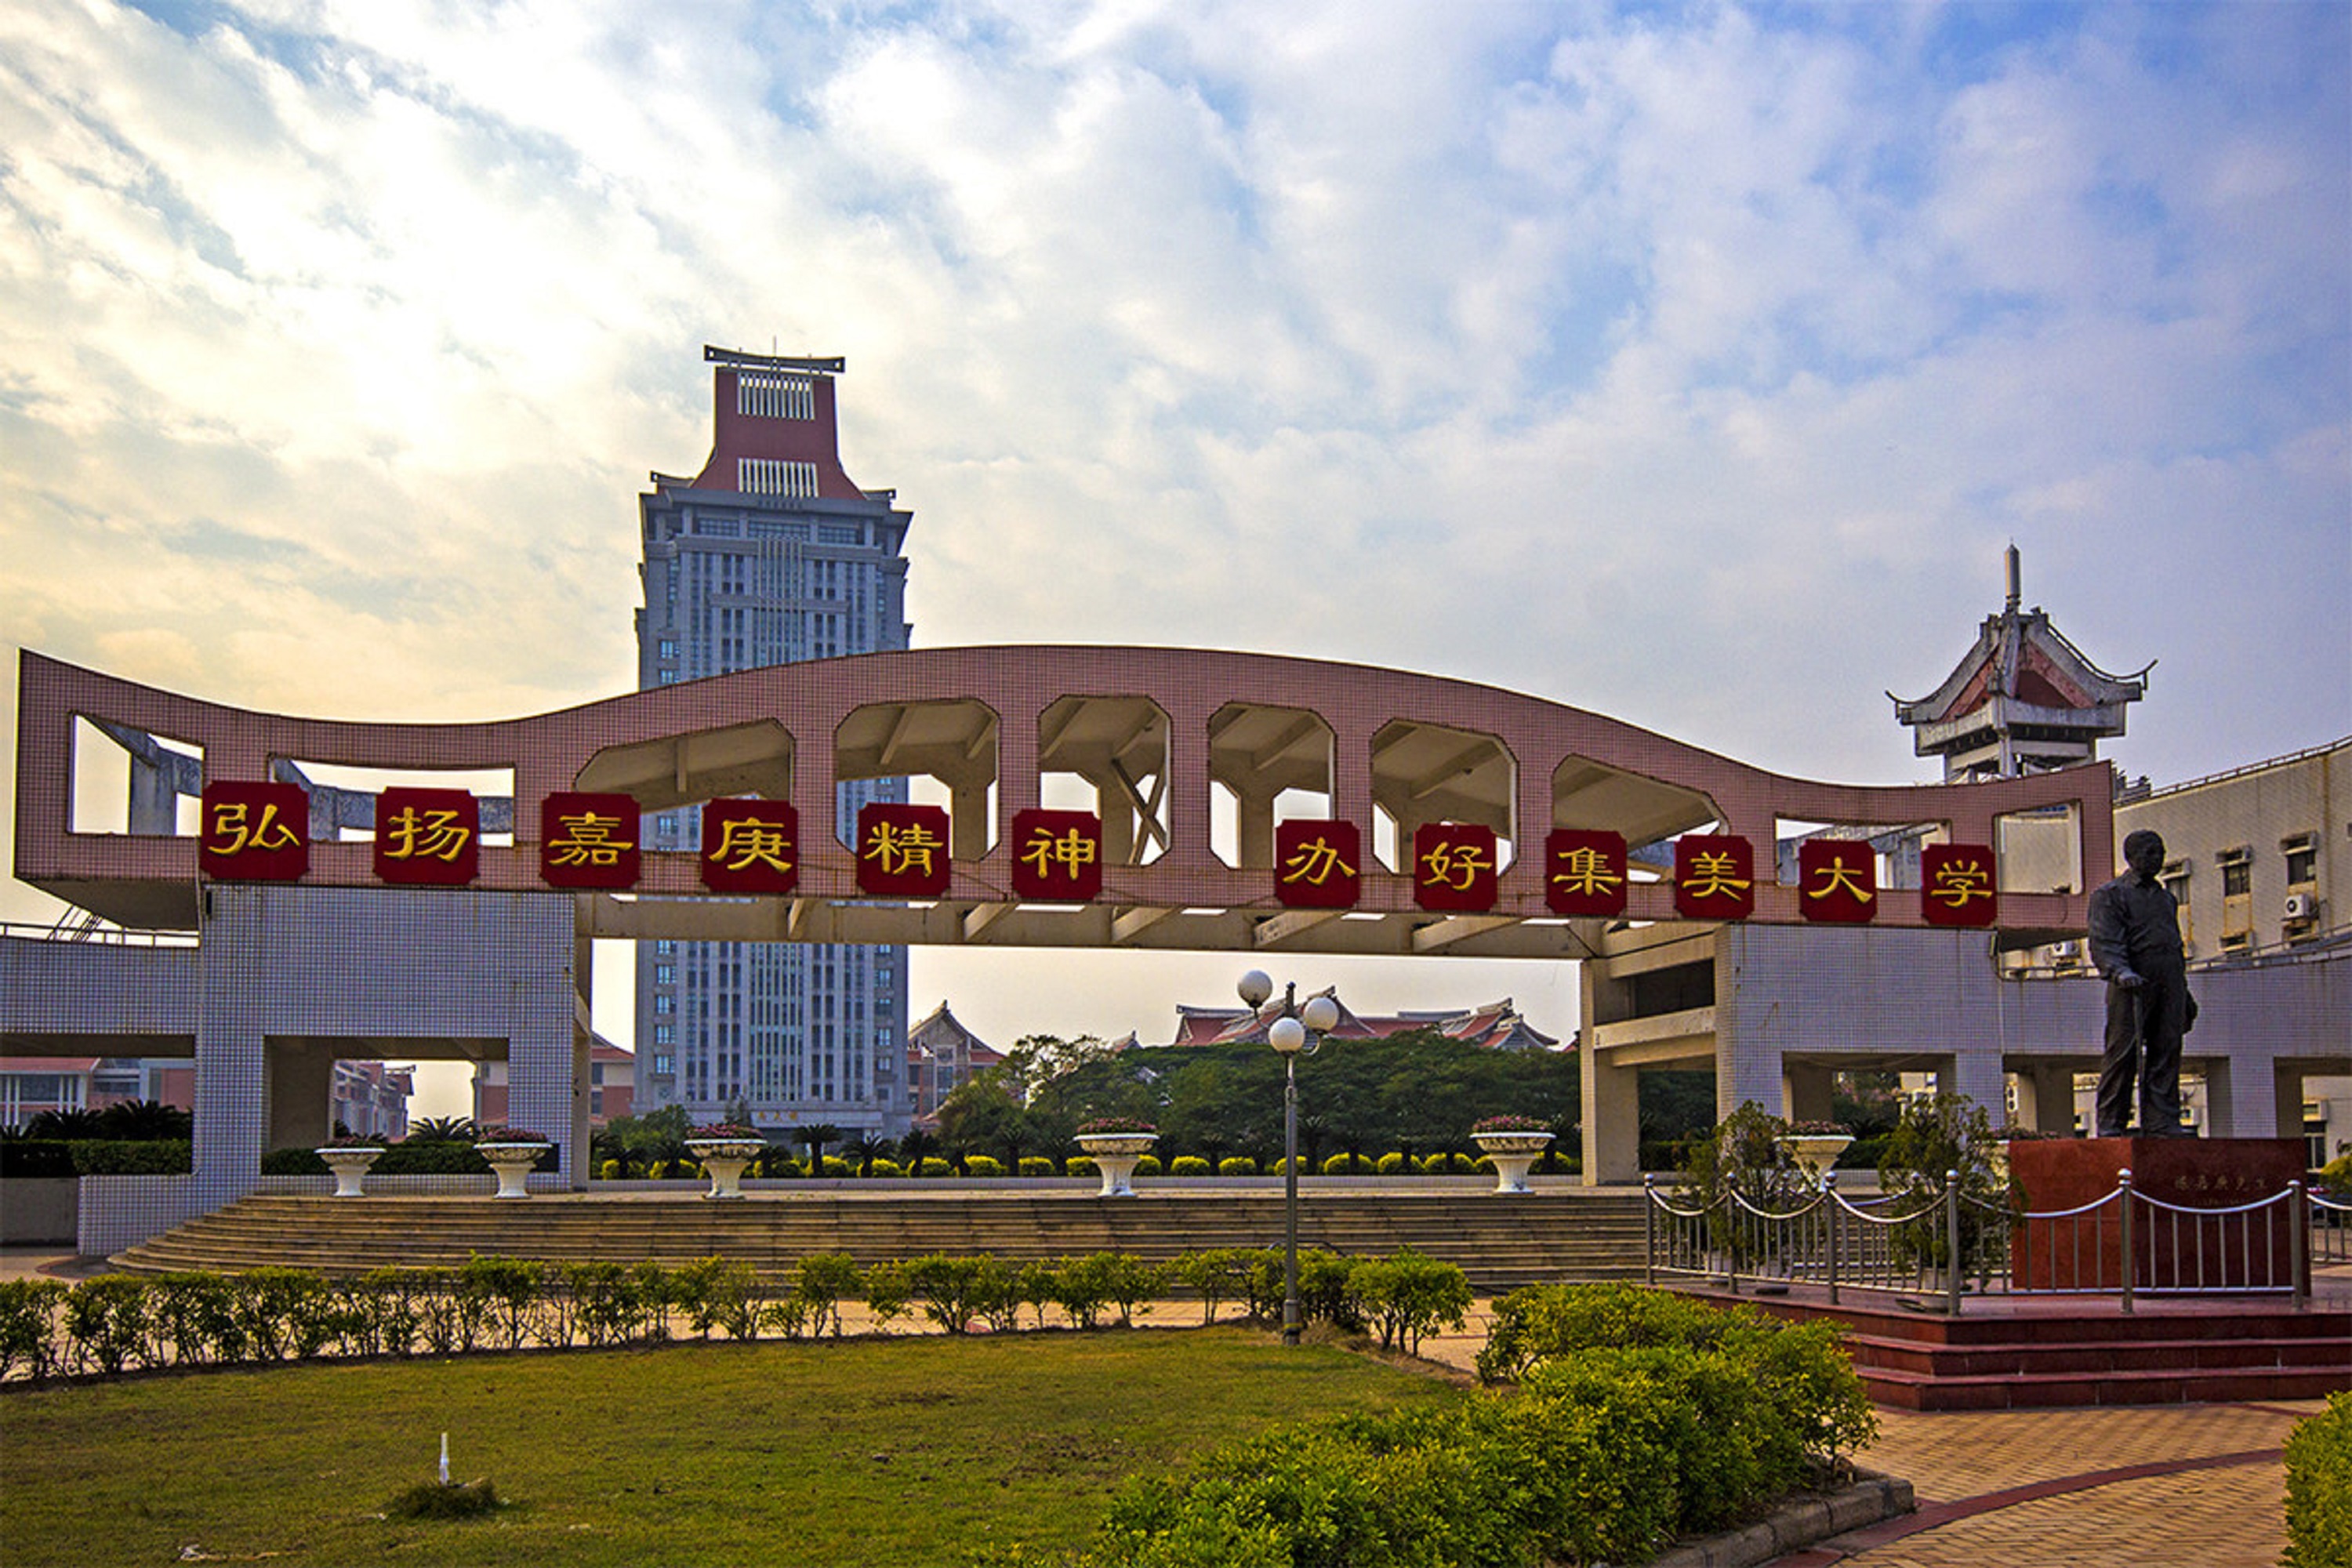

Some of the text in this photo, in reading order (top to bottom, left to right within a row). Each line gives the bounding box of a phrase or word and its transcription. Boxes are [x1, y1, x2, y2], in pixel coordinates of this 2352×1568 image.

[209, 803, 1993, 907] 弘扬嘉庚精神 办好集美大学
